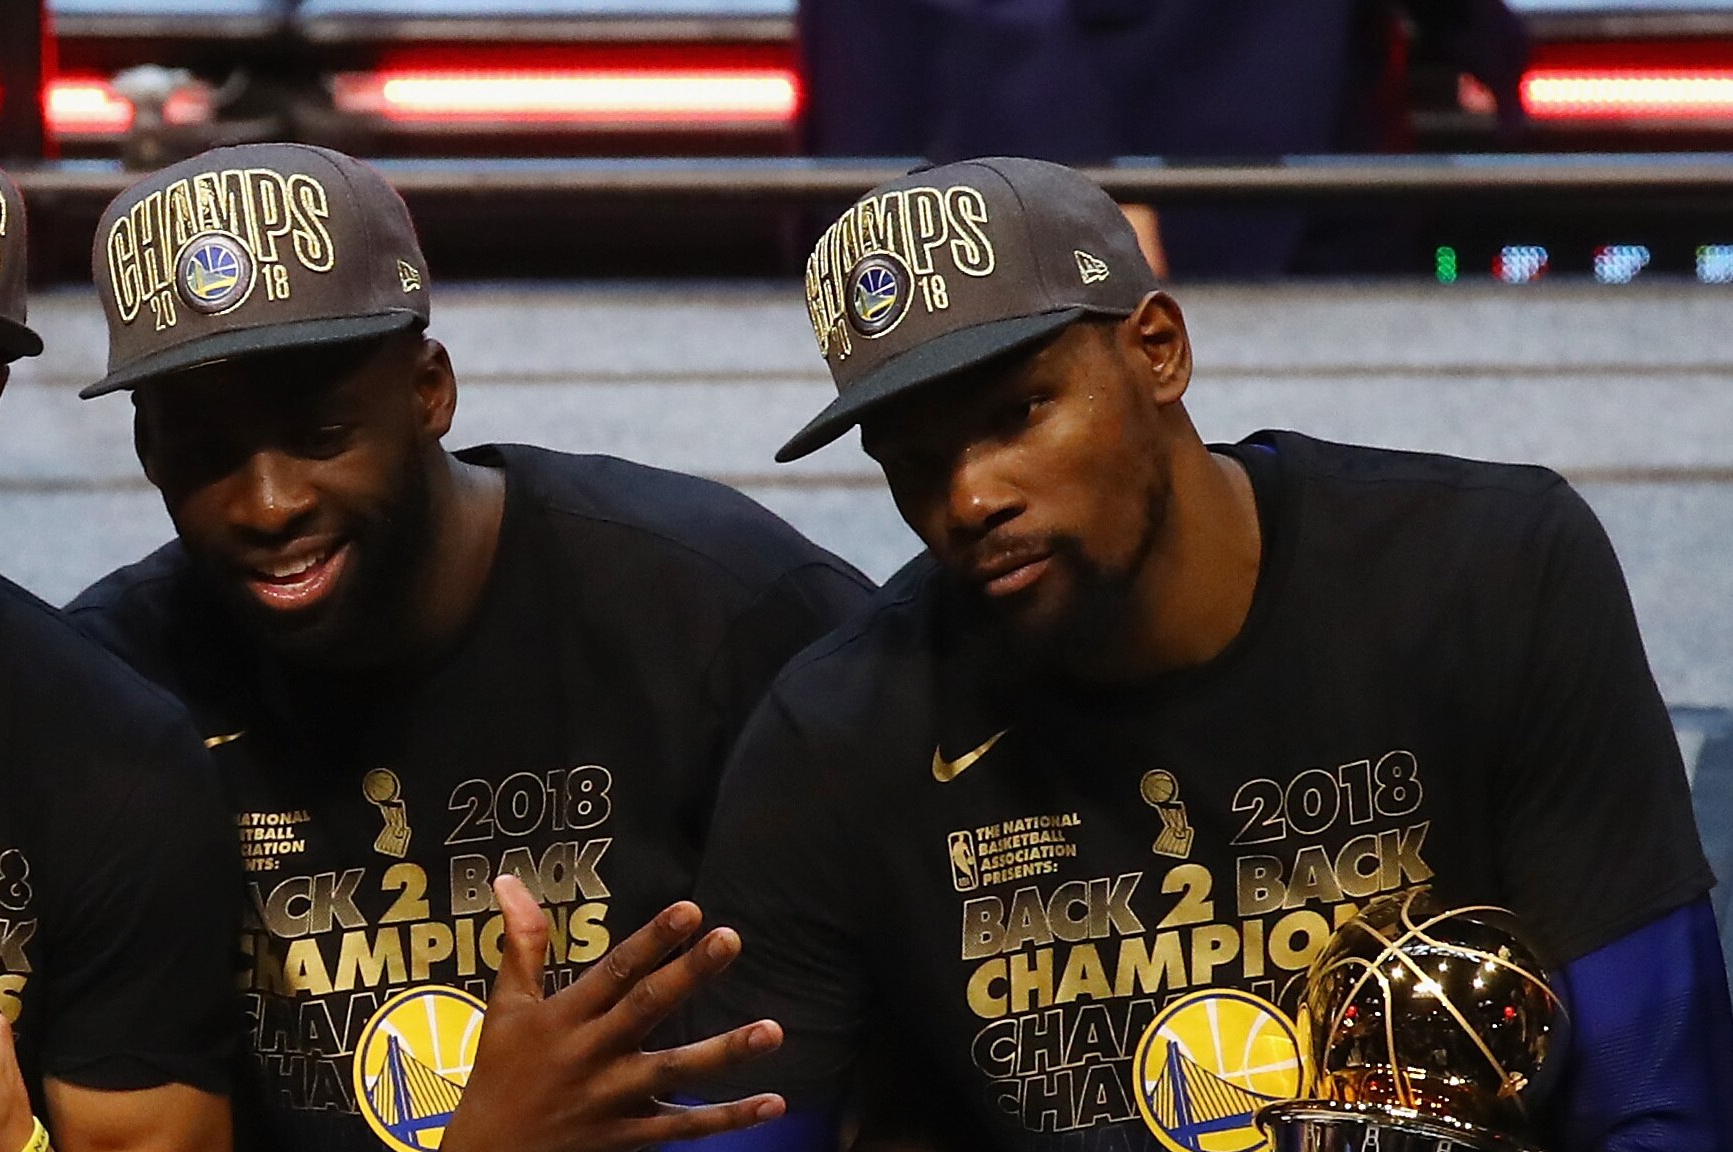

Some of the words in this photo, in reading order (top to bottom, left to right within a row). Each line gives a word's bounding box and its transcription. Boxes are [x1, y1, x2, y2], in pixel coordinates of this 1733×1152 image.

[107, 168, 336, 323] CHAMPS
[261, 264, 291, 301] 18
[918, 274, 949, 313] 18
[151, 289, 177, 331] 20
[443, 764, 613, 846] 2018
[1230, 749, 1424, 847] 2018
[237, 810, 311, 826] ATIONAL
[975, 823, 1001, 841] THE
[1003, 812, 1082, 834] NATIONAL
[978, 830, 1066, 857] BASKETBALL
[980, 843, 1077, 872] ASSOCIATION
[961, 870, 1148, 961] BACK
[1155, 863, 1215, 930] 2
[1235, 819, 1436, 918] BACK
[982, 860, 1059, 887] PRESENTS:
[378, 862, 431, 925] 2
